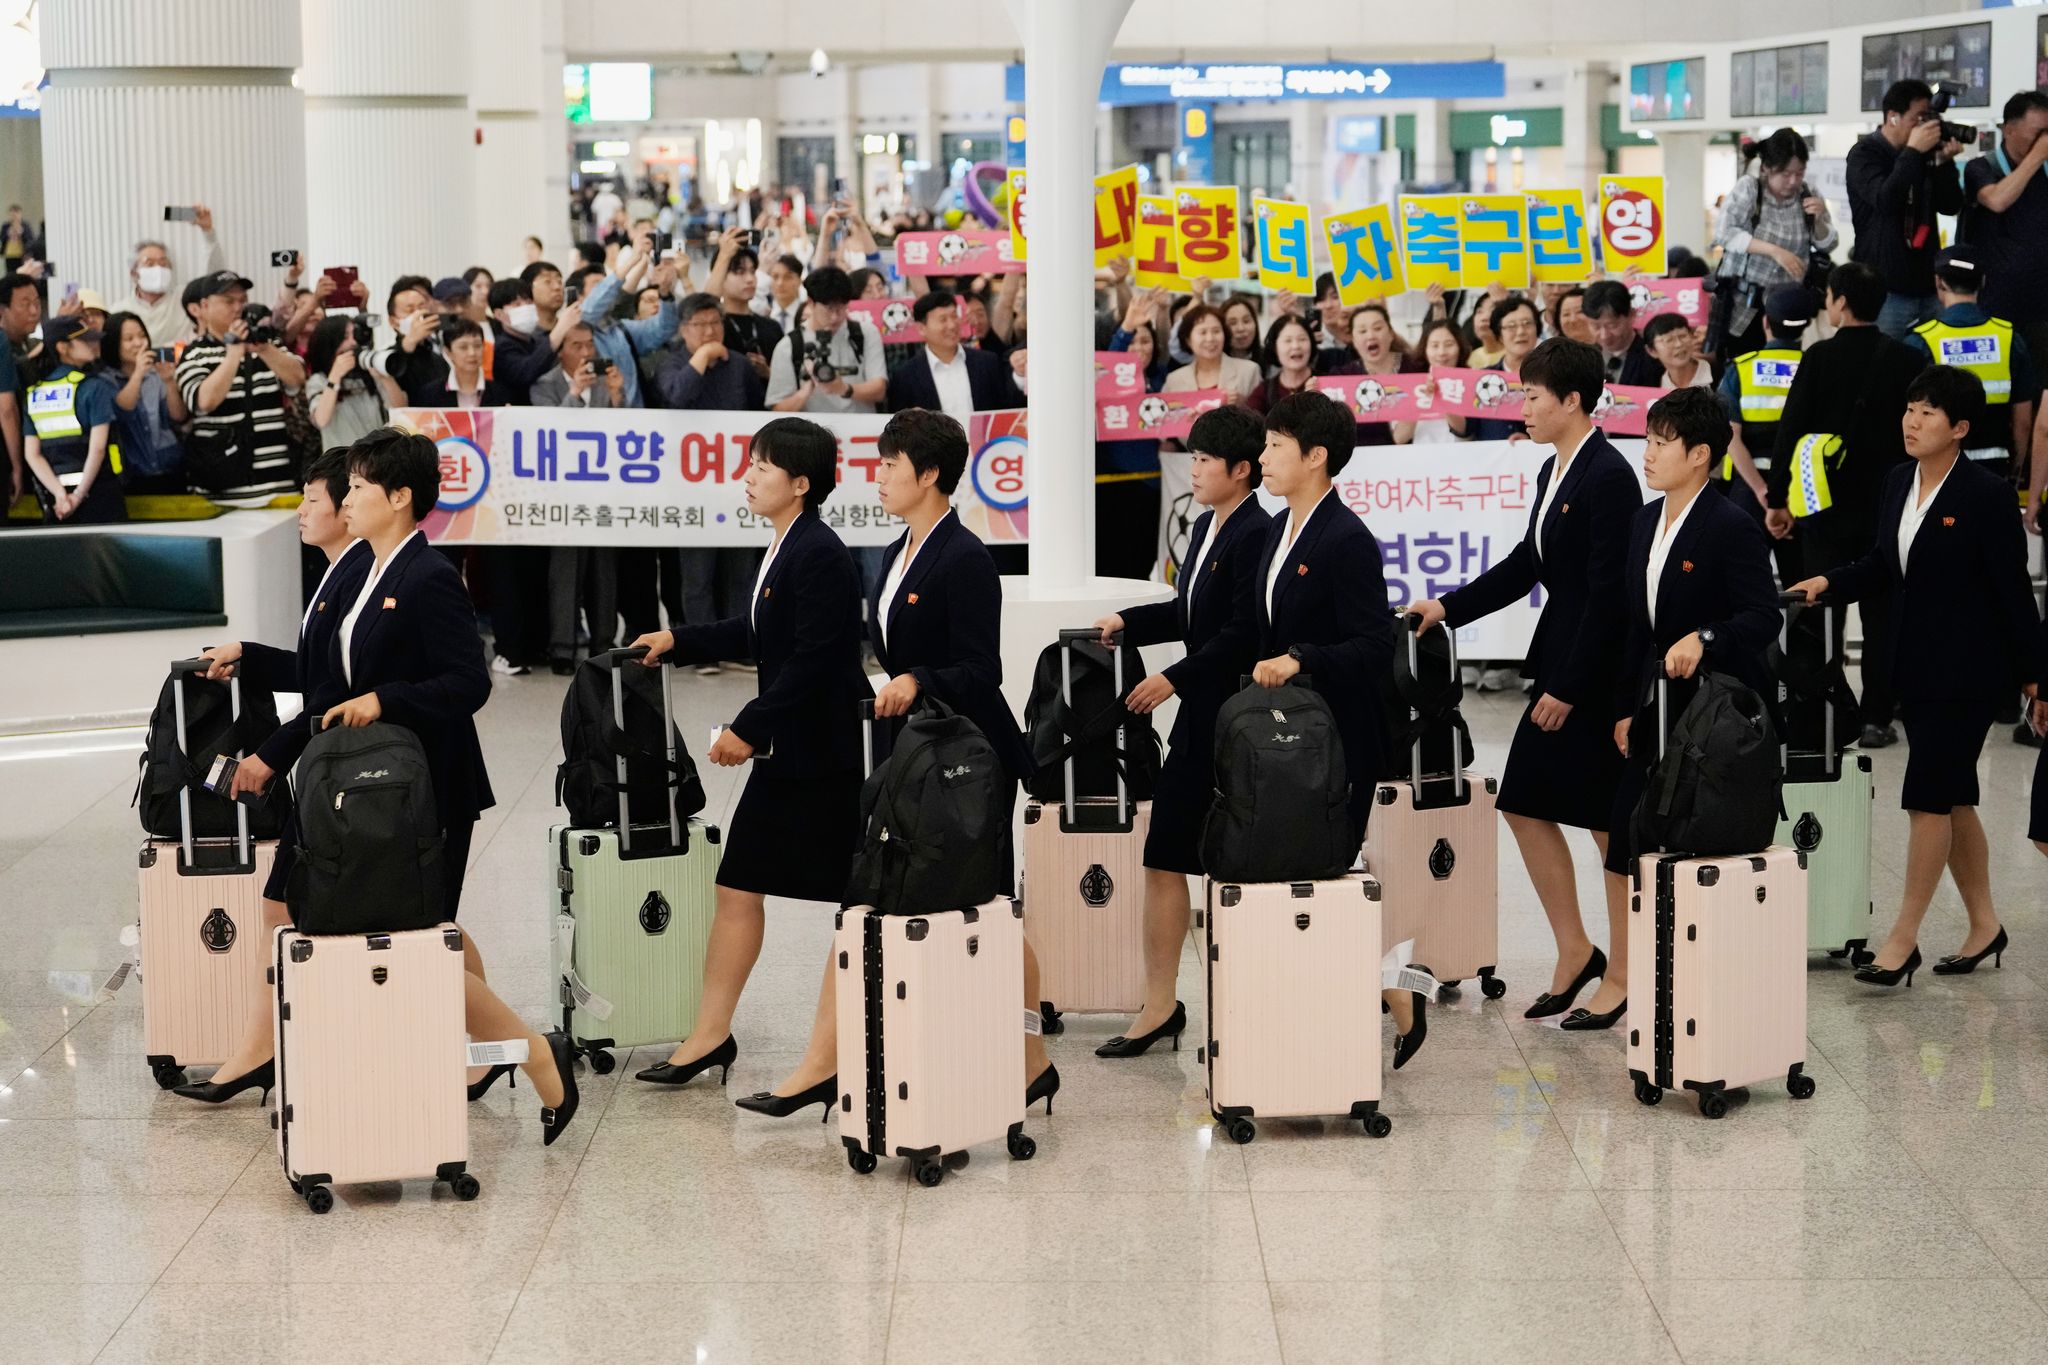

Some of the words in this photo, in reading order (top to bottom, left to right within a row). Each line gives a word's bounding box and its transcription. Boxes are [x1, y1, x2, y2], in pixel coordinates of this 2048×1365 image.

[1178, 203, 1235, 263] 향
[1258, 217, 1308, 278] 녀
[1406, 212, 1460, 271] 축
[1464, 210, 1524, 270] 구
[1528, 205, 1583, 265] 단
[1605, 198, 1654, 251] 영
[1332, 220, 1393, 287] 자
[1948, 354, 1992, 363] POLICE
[438, 455, 472, 492] 환
[513, 429, 665, 483] 내고향
[991, 455, 1024, 493] 영
[504, 503, 704, 528] 인천미추홀구체육회
[1334, 473, 1529, 515] 향여자축구단
